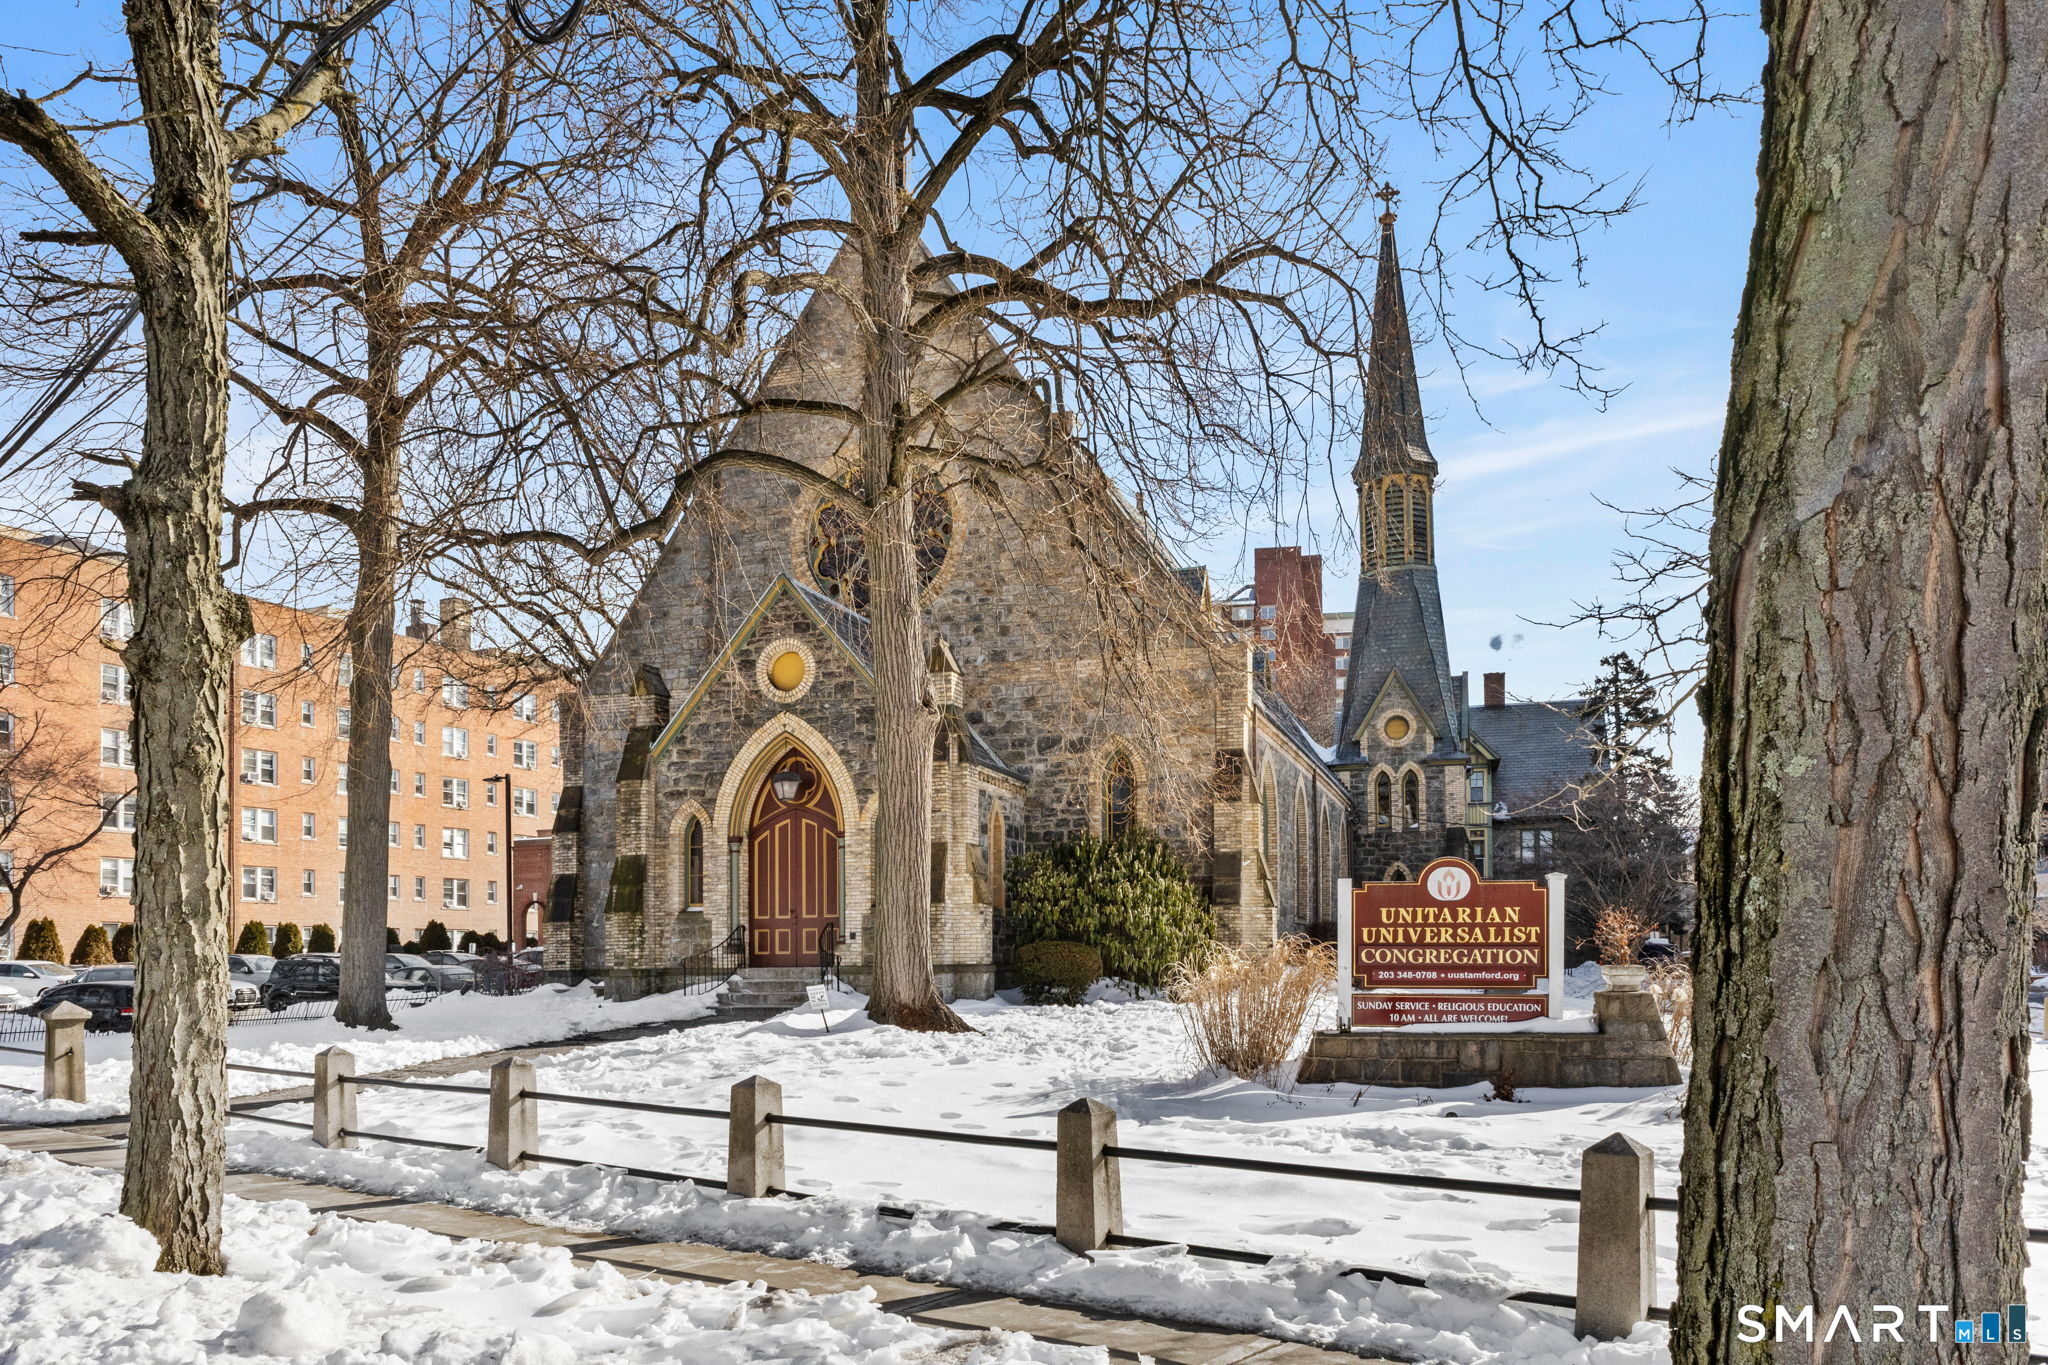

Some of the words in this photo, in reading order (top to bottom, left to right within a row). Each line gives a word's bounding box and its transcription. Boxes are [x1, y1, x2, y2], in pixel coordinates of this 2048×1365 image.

[1379, 906, 1521, 924] UNITARIAN
[1360, 926, 1541, 944] UNIVERSALIST
[1360, 948, 1540, 965] CONGREGATION
[1378, 971, 1395, 979] 203
[1396, 971, 1437, 979] 348-0708
[1447, 971, 1520, 981] uustamford.org
[1357, 1001, 1393, 1010] SUNDAY
[1395, 1001, 1430, 1011] SERVICE
[1437, 1002, 1485, 1011] RELIGIOUS
[1487, 1003, 1542, 1012] EDUCATION
[1389, 1013, 1400, 1022] 10
[1400, 1013, 1416, 1022] AM
[1423, 1014, 1439, 1023] ALL
[1441, 1014, 1458, 1023] ARE
